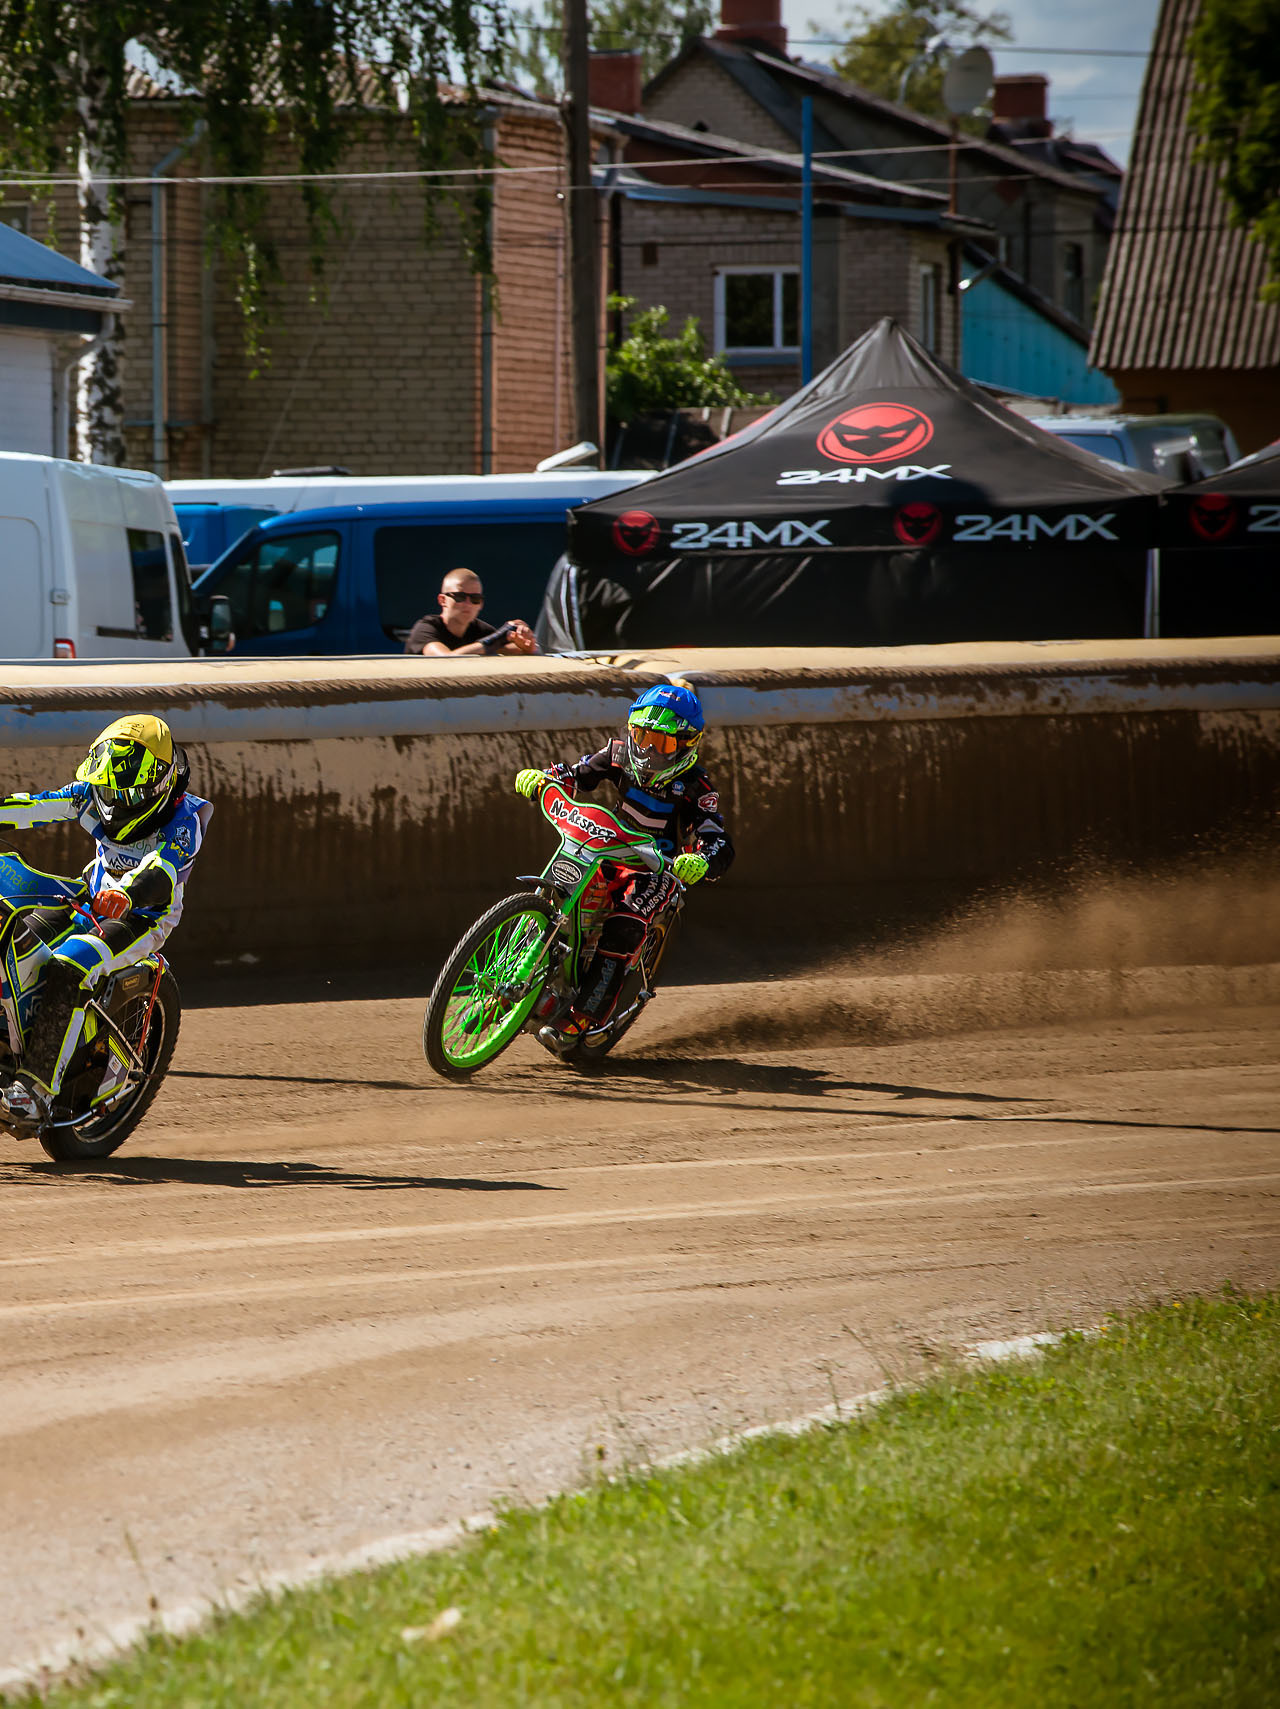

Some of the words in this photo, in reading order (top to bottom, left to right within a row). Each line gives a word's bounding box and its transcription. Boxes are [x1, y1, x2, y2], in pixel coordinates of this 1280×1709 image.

[776, 464, 952, 486] 24MX
[670, 519, 833, 549] 24MX
[952, 513, 1119, 542] 24MX
